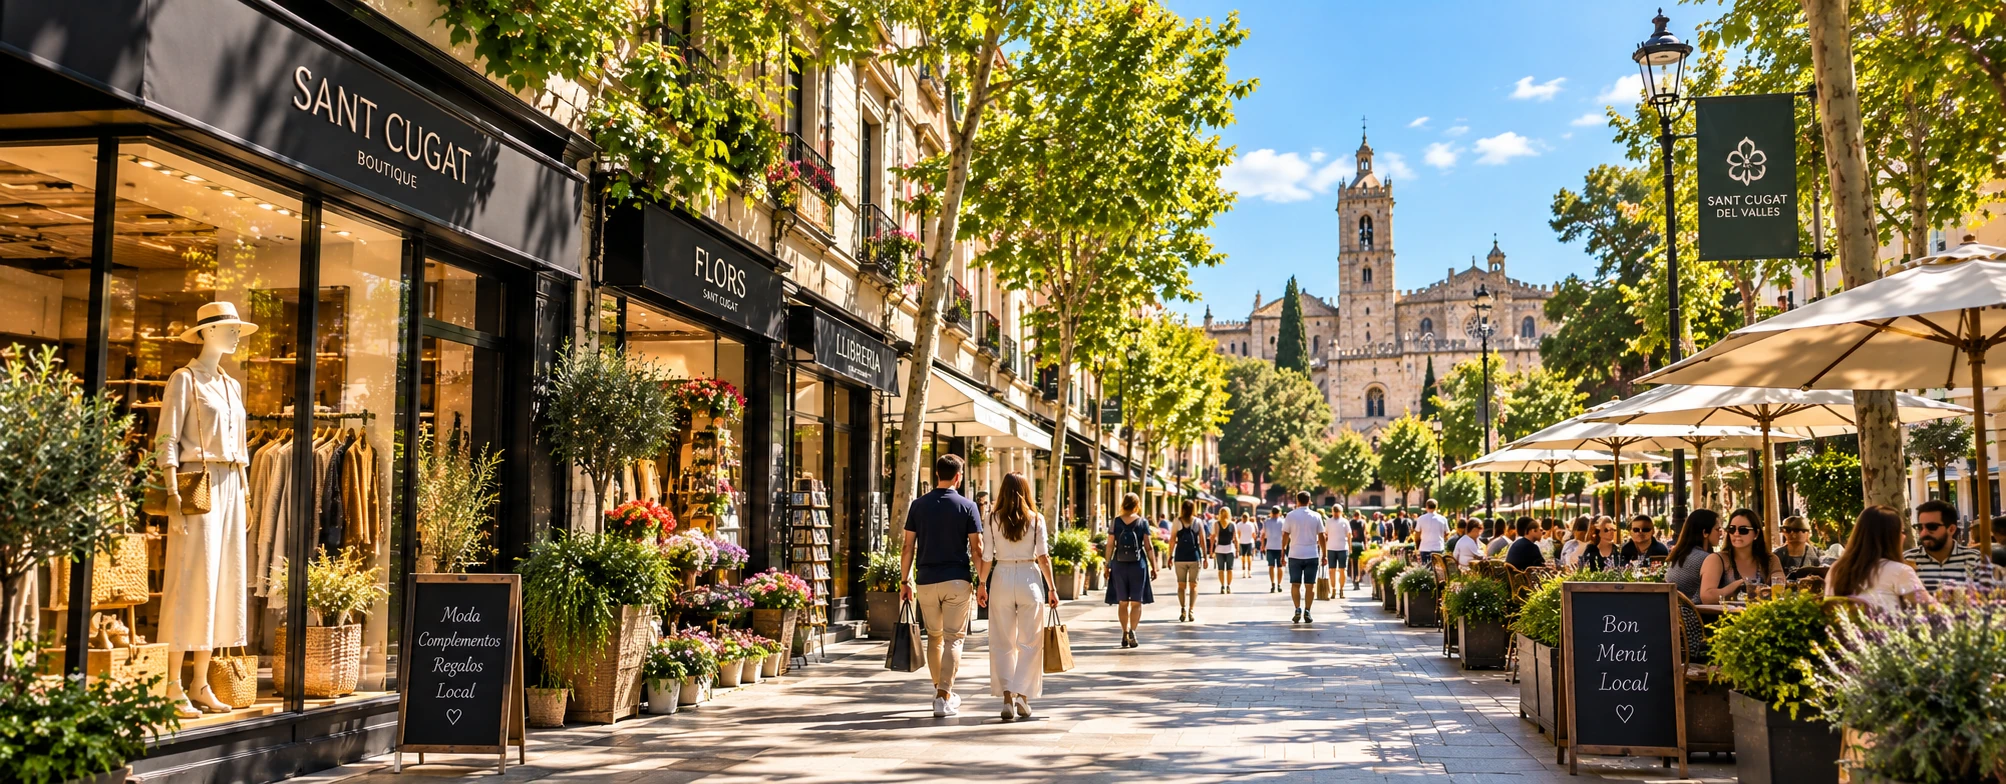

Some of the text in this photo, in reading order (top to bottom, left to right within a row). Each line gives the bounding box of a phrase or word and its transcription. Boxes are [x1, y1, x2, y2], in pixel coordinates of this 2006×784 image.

[293, 66, 472, 184] SANT CUGAT
[357, 150, 417, 189] BOUTIQUE
[1707, 194, 1788, 206] SANT CUGAT
[1716, 207, 1780, 218] DEL VALLES
[695, 246, 746, 299] FLORS
[703, 288, 719, 304] SANT
[836, 333, 881, 373] LLIBRERIA
[440, 606, 481, 622] Moda
[1602, 614, 1640, 633] Bon
[418, 631, 501, 652] Complementos
[1596, 643, 1648, 662] Menú
[432, 656, 484, 678] Regalos
[435, 682, 477, 699] Local
[1599, 672, 1649, 692] Local
